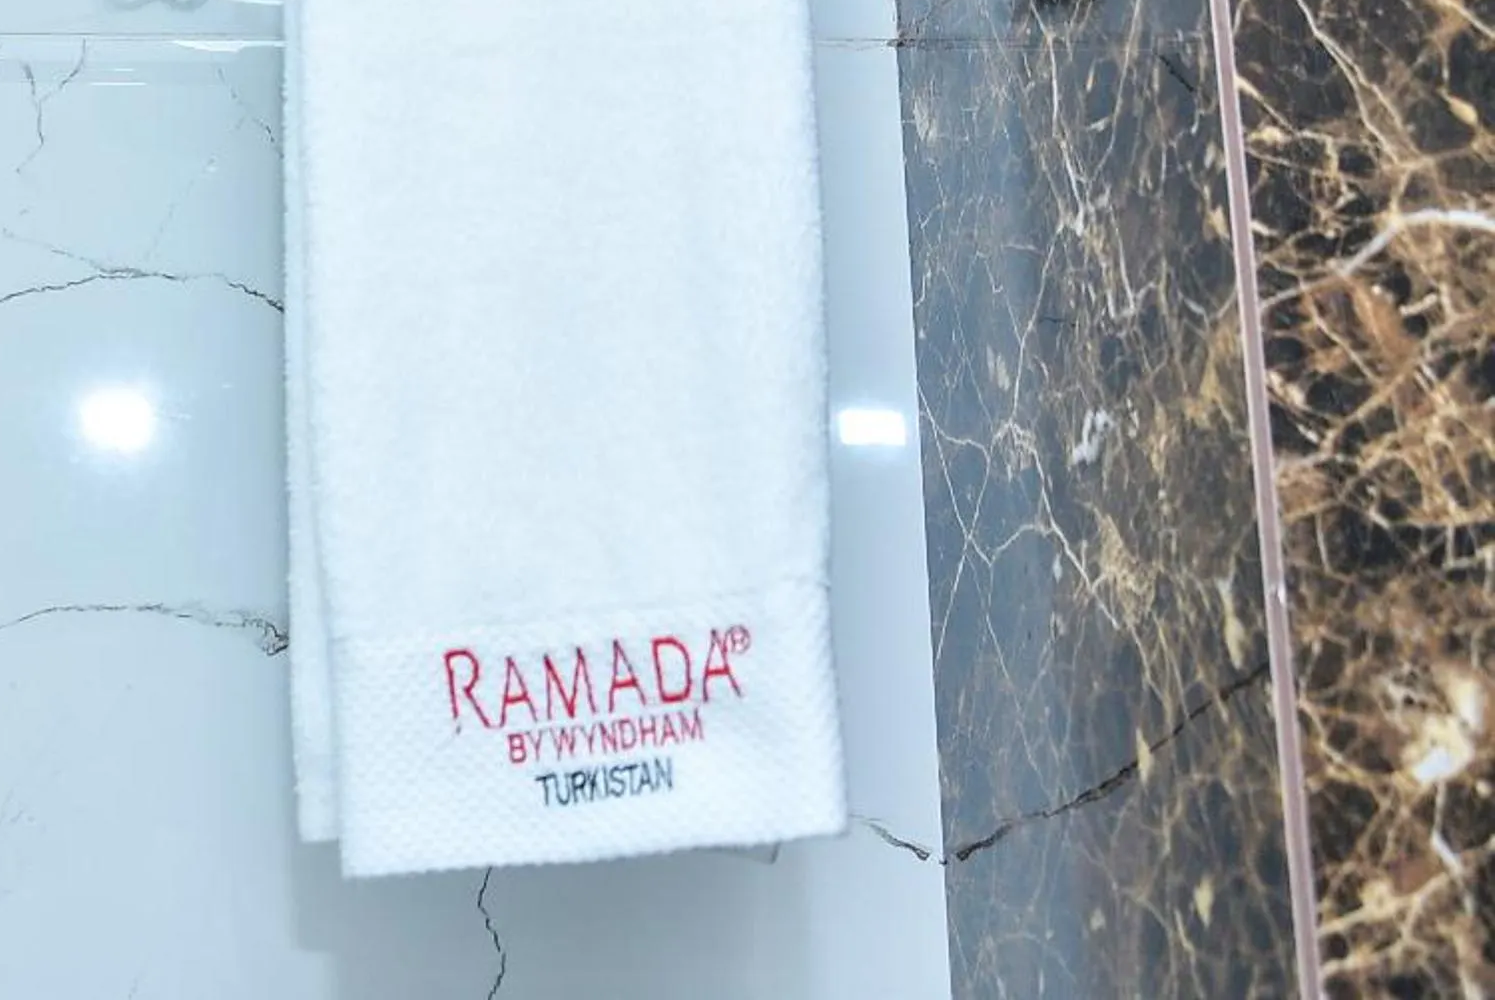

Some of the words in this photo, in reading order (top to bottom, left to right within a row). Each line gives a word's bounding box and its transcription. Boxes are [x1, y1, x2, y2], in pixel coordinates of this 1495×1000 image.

[507, 730, 543, 764] BY
[551, 708, 705, 761] WYNDHAM
[534, 756, 674, 807] TURKISTAN
